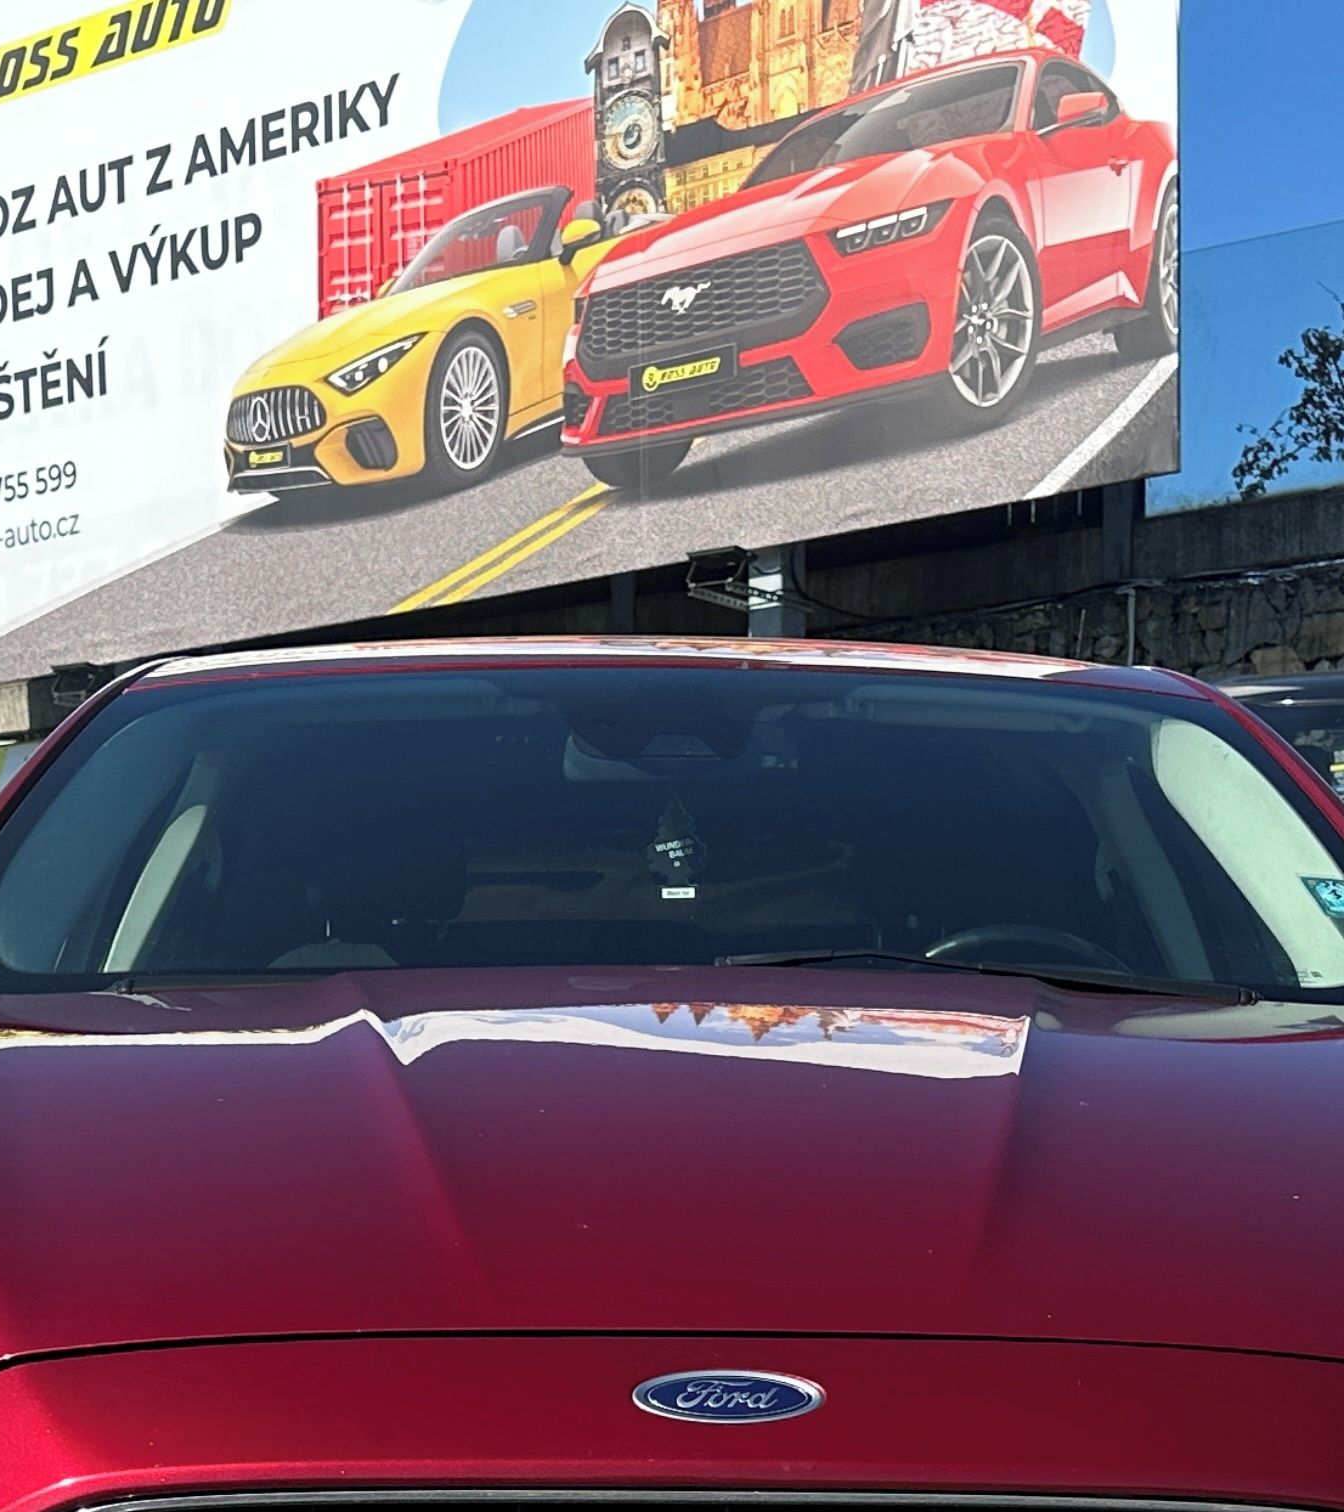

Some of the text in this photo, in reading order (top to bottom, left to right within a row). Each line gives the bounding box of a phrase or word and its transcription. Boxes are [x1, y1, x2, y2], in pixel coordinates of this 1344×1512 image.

[90, 0, 226, 68] AUTO
[47, 156, 134, 225] AUT
[146, 143, 172, 196] Z
[184, 73, 400, 185] AMERIKY
[67, 258, 100, 308] A
[108, 212, 263, 293] VÝKUP
[34, 461, 77, 496] 599
[676, 1379, 778, 1409] Ford
